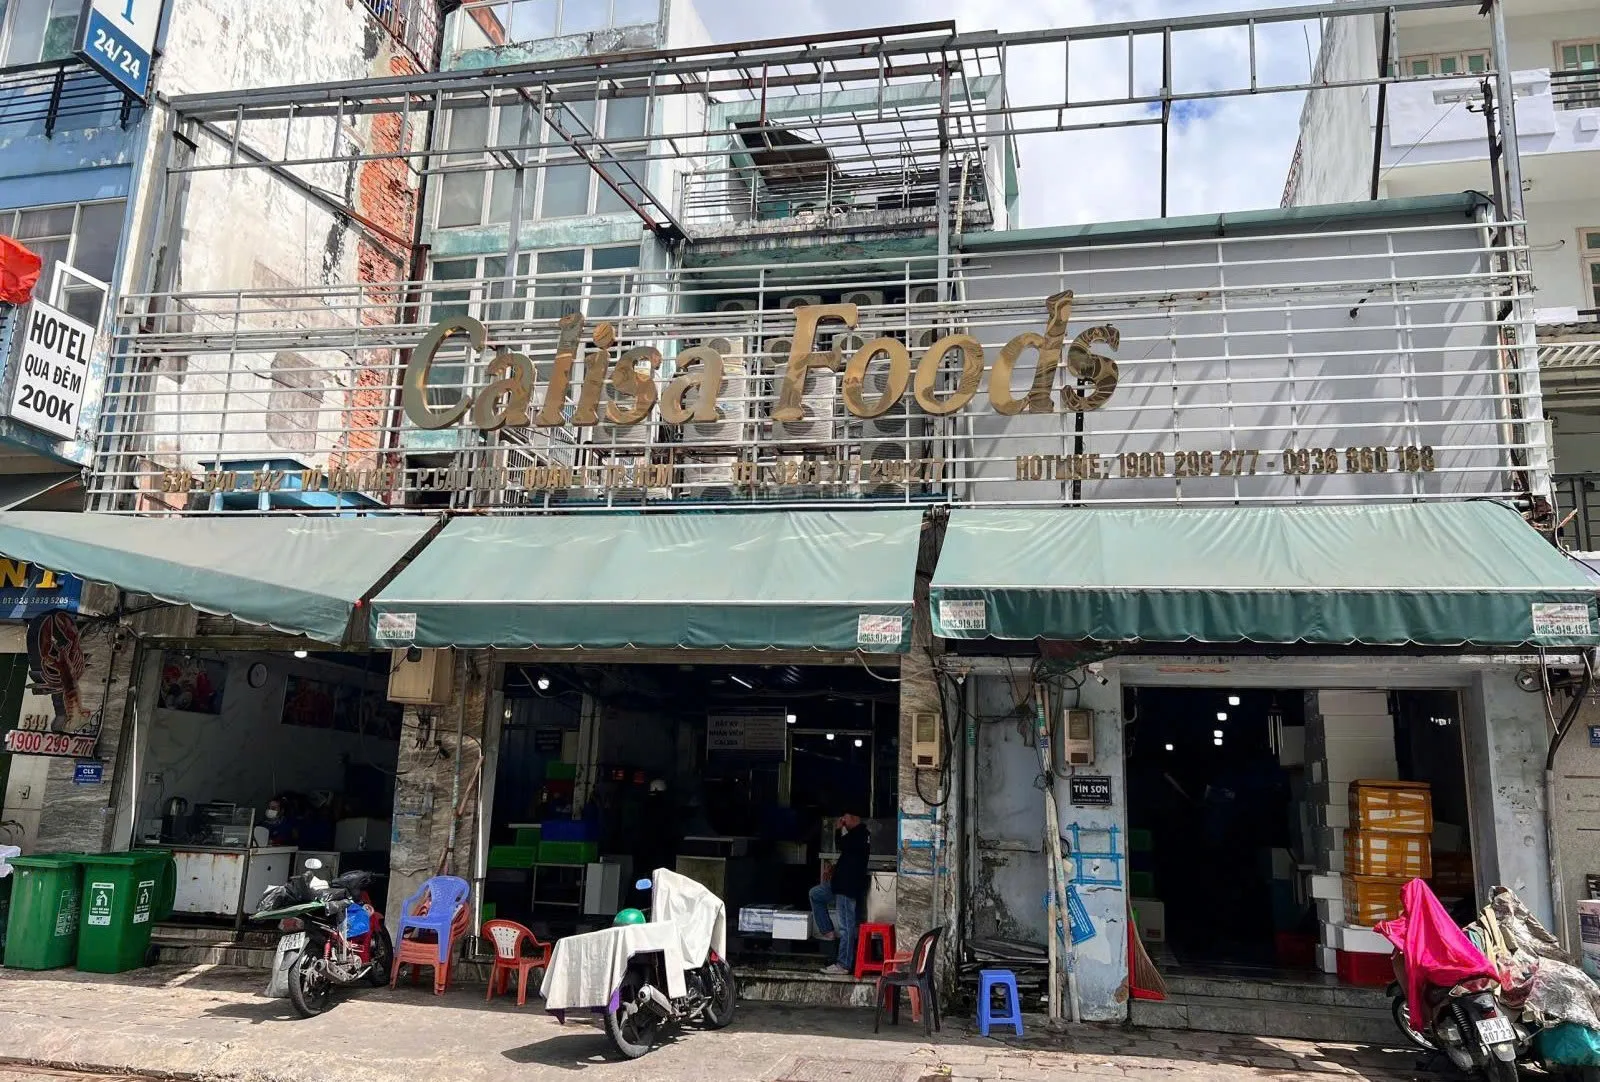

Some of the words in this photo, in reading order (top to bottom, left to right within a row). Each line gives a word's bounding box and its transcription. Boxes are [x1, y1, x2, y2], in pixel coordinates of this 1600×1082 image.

[93, 28, 140, 80] 24/24
[29, 309, 86, 366] HOTEL
[24, 353, 49, 381] QUA
[52, 365, 82, 394] ĐÊM
[403, 311, 724, 430] Calisa
[771, 289, 1120, 420] Foods
[18, 384, 74, 425] 200K
[252, 469, 285, 492] 542
[633, 463, 673, 488] HCM
[1118, 451, 1166, 478] 1900
[1174, 450, 1213, 477] 299
[1218, 449, 1259, 476] 277
[1282, 448, 1337, 475] 0936
[1345, 446, 1388, 473] 860
[1394, 445, 1436, 472] 168
[9, 731, 41, 751] 1900
[44, 735, 69, 753] 299
[23, 714, 48, 731] 544
